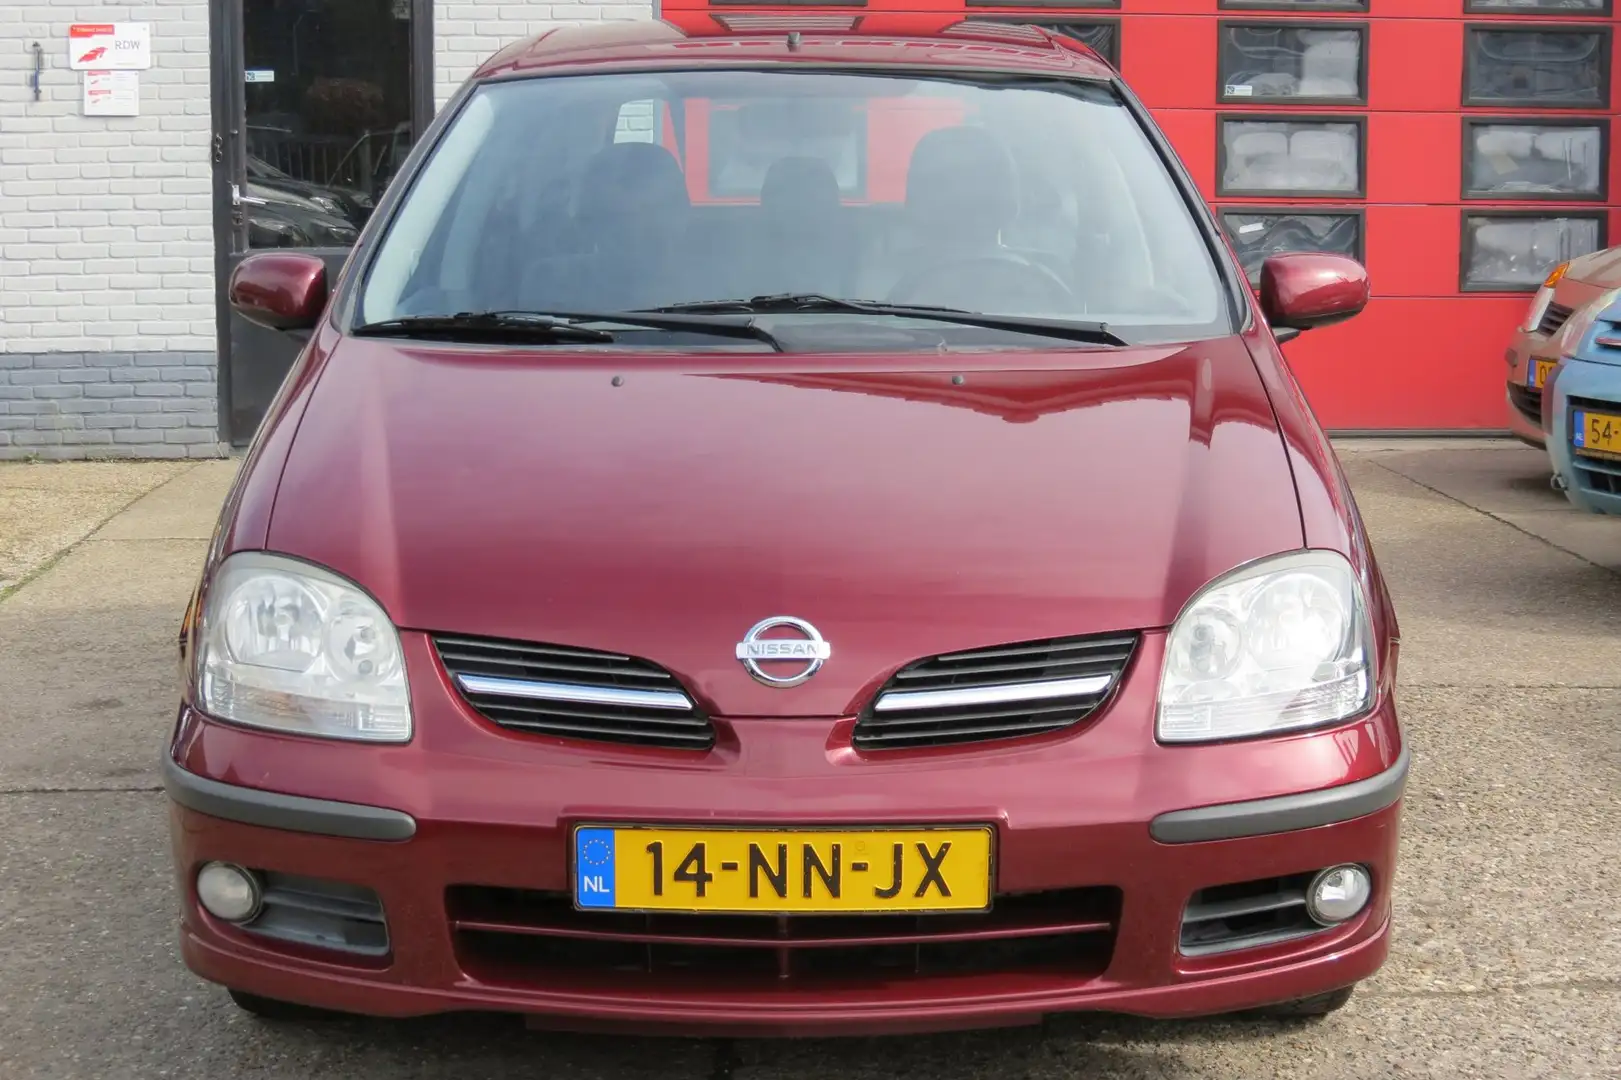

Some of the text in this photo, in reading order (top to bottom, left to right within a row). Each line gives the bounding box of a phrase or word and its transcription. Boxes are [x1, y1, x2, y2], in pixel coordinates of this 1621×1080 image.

[115, 40, 140, 50] RDW
[746, 643, 819, 656] NISSAN
[646, 841, 952, 899] 14-NN-JX
[583, 875, 610, 893] NL
